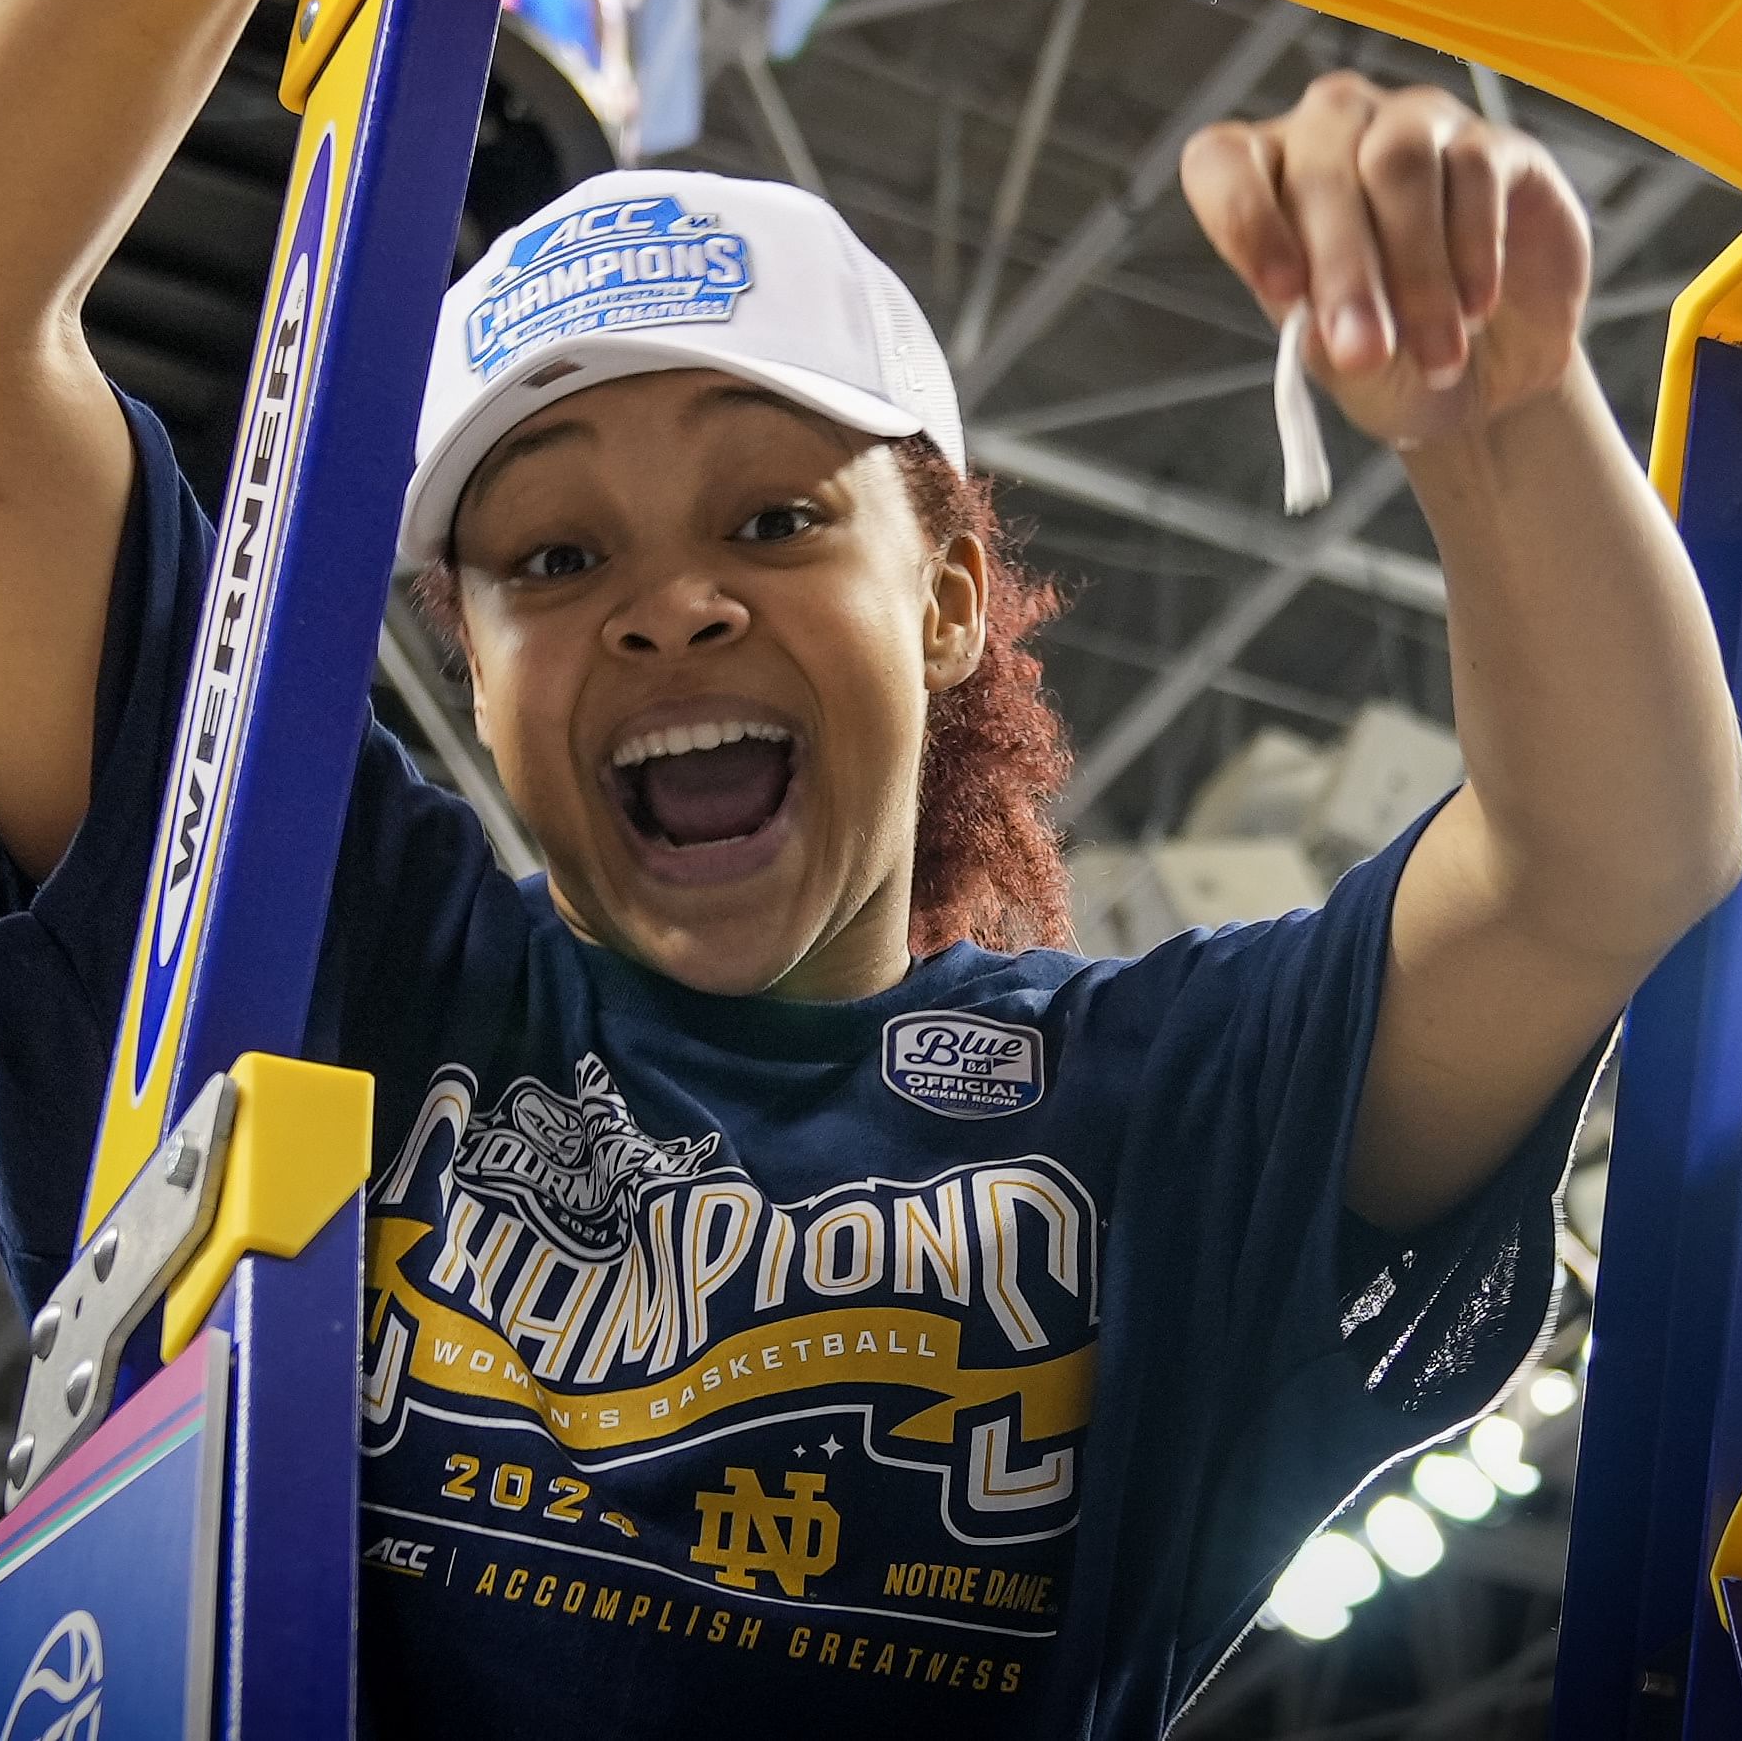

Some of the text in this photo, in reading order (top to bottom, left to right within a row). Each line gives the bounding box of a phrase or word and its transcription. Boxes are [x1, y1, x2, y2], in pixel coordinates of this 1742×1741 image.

[527, 199, 662, 261] ACC
[468, 237, 744, 359] CHAMPIONS
[169, 314, 298, 892] WERNER
[904, 1026, 1023, 1067] Blue
[904, 1073, 1023, 1099] OFFICIAL
[910, 1086, 968, 1102] LOCKER
[972, 1093, 1018, 1107] ROOM
[432, 1331, 939, 1431] WOMN'S BASKETBALL
[362, 1535, 1023, 1693] ACC ACCOMPLISH GREATNESS
[882, 1562, 1054, 1614] NOTRE DAME
